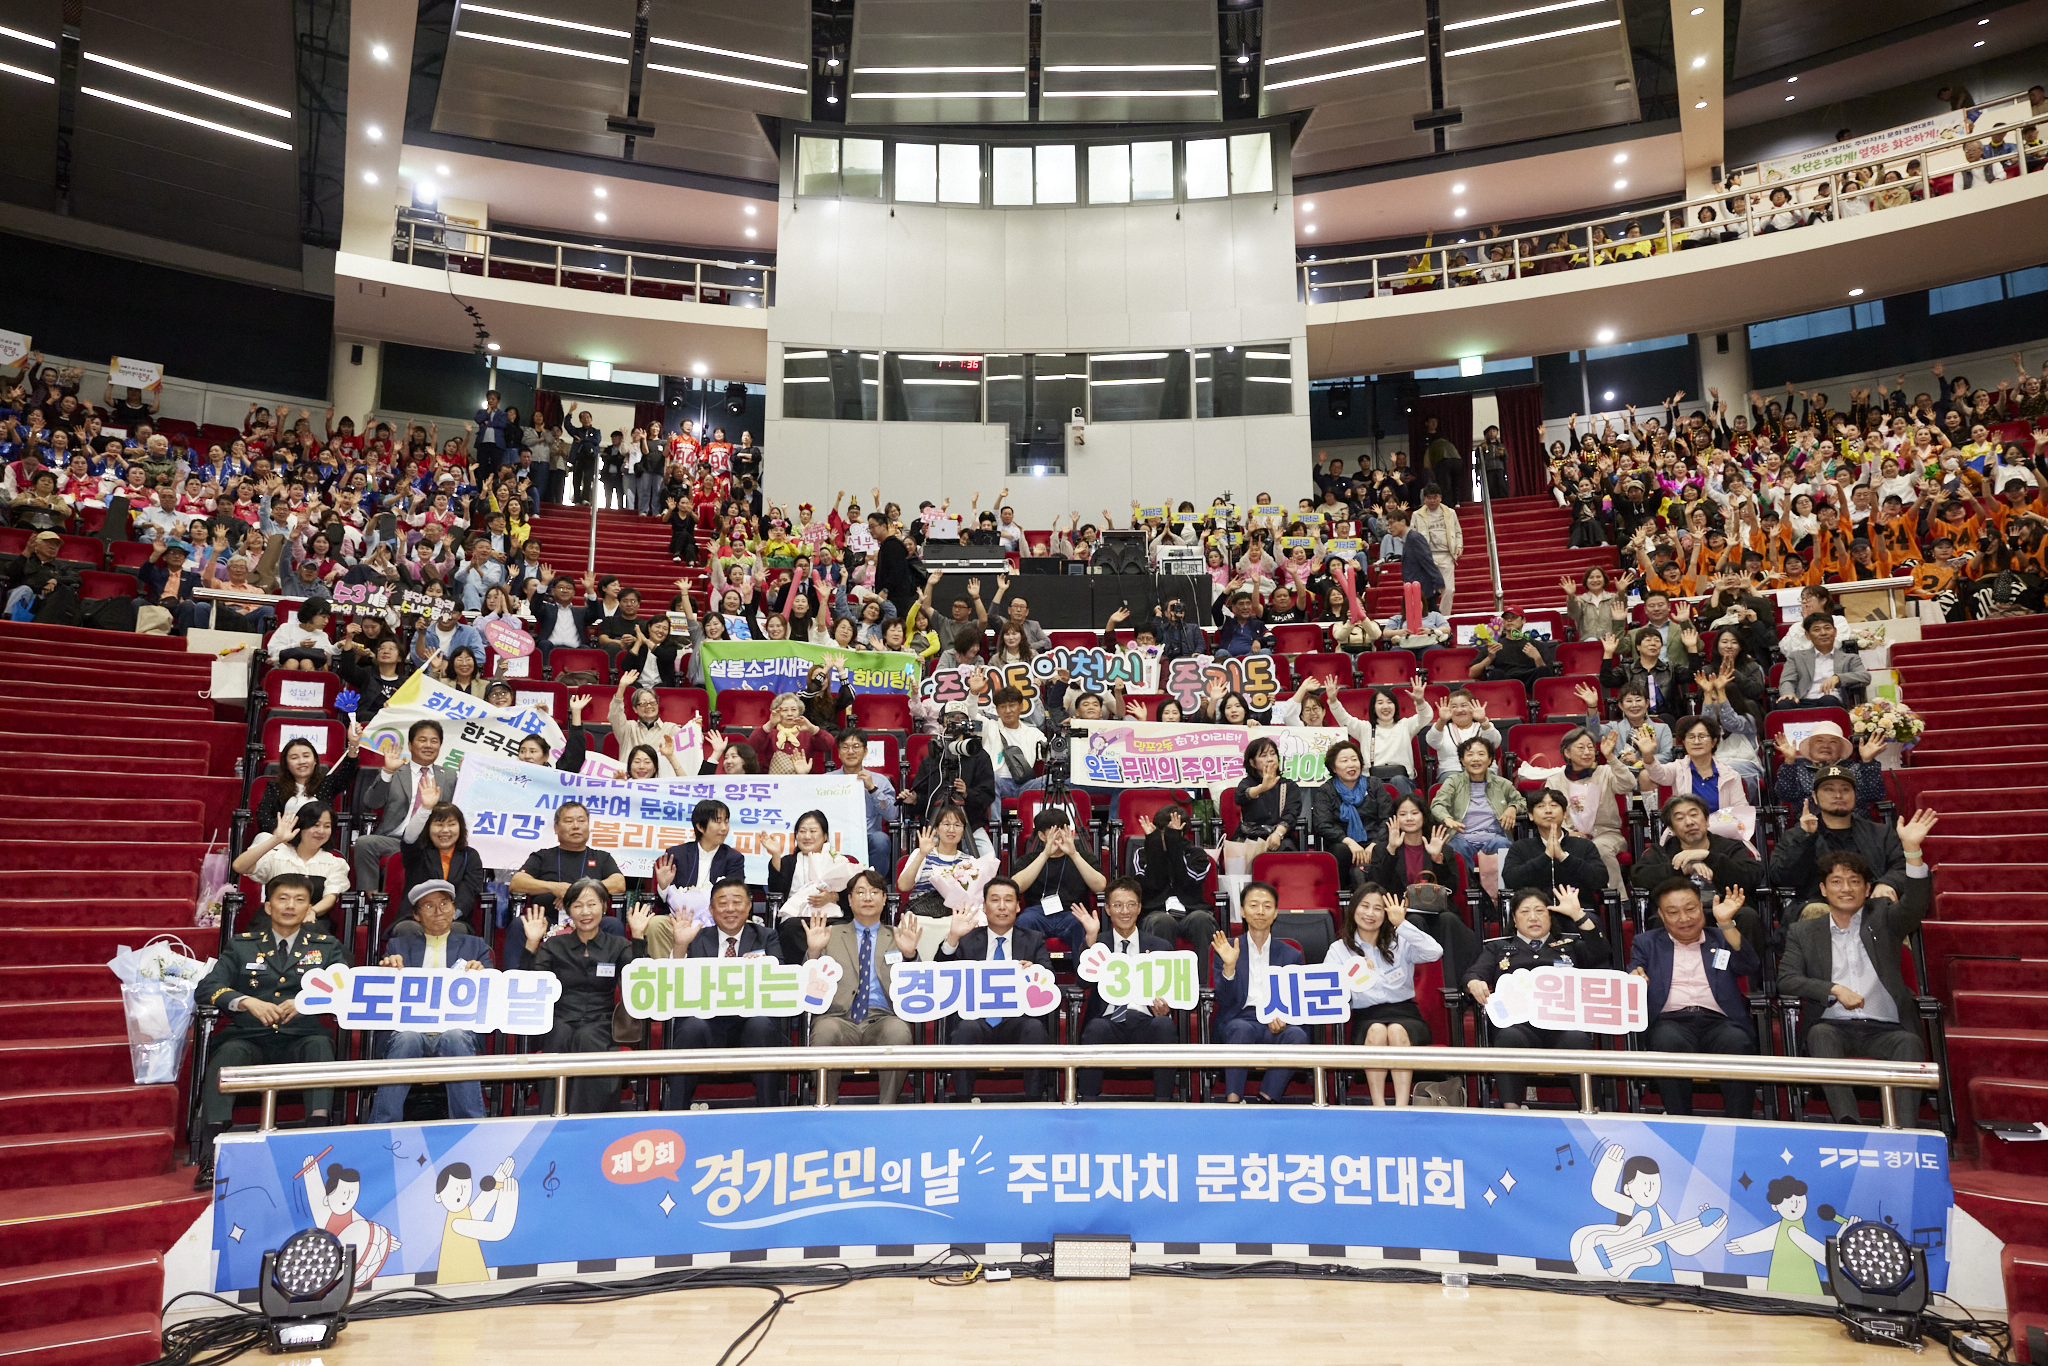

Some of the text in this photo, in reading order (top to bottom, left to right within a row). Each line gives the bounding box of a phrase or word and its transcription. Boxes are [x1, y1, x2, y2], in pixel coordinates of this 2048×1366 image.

[1790, 158, 1822, 174] 장단은
[1824, 151, 1857, 167] 뜨겁게!
[1859, 142, 1889, 159] 열정은
[1892, 128, 1939, 150] 화끈하게!
[1803, 149, 1829, 159] 2026년
[1831, 143, 1852, 152] 경기도
[1855, 134, 1885, 146] 주민자치
[1213, 508, 1235, 516] 가평
[852, 668, 911, 690] 화이팅!
[1037, 651, 1142, 691] 이천시
[1172, 660, 1275, 709] 중리동
[460, 721, 523, 759] 한국무
[1133, 739, 1173, 752] 망포2동
[1174, 733, 1199, 747] 최강
[1085, 755, 1121, 781] 오늘
[1121, 756, 1178, 782] 무대의
[535, 793, 631, 818] 시민참여
[739, 807, 791, 830] 양주,
[472, 810, 545, 841] 최강
[732, 831, 841, 855] 파이!
[629, 963, 799, 1012] 하나되는
[898, 968, 1018, 1014] 경기도
[1105, 958, 1191, 1001] 31개
[1264, 971, 1343, 1017] 시군
[1533, 973, 1640, 1027] 원팀!
[347, 975, 553, 1026] 도민의 날
[610, 1138, 676, 1176] 제9회
[1883, 1150, 1940, 1170] 경기도
[690, 1146, 1466, 1217] 경기도민의 날 주민자치 문화경연대회
